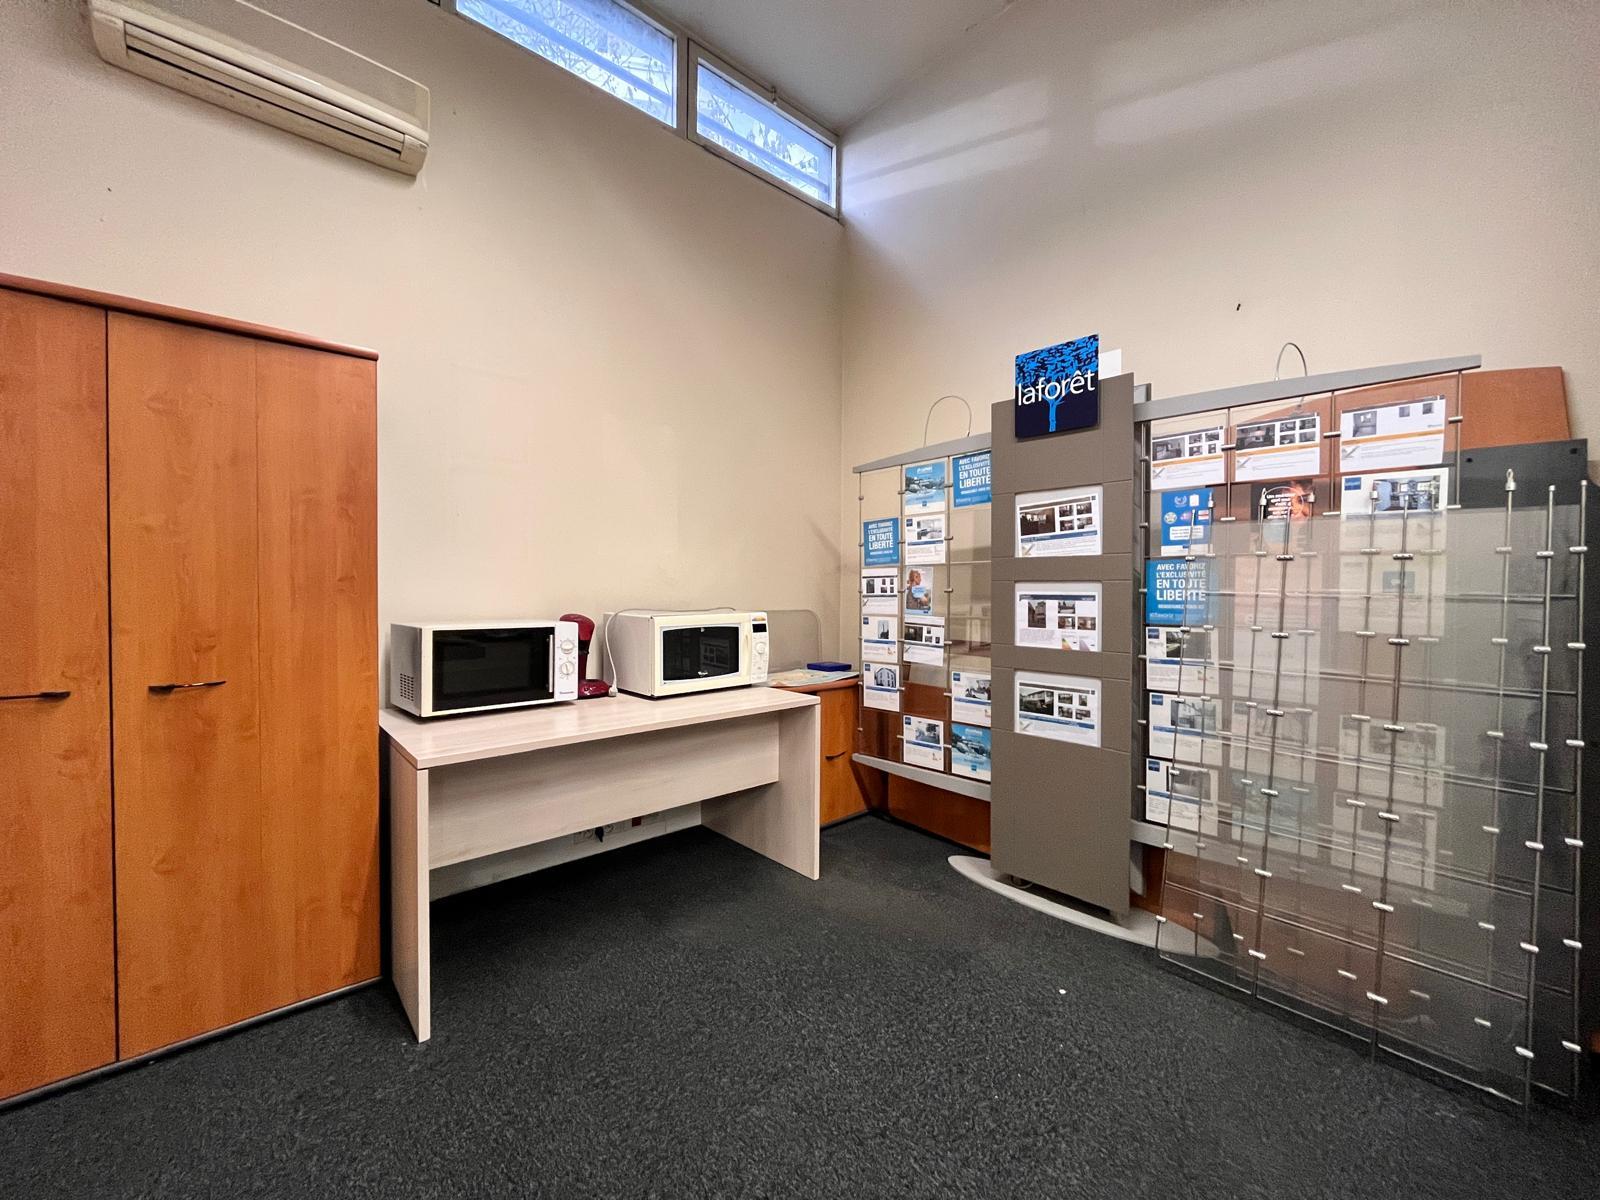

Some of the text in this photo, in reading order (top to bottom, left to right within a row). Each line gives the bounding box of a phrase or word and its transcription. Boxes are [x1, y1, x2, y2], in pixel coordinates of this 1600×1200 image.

[1018, 369, 1096, 406] laforêt
[959, 466, 991, 480] EN TOUTE
[1157, 563, 1175, 571] AVEC
[1156, 579, 1170, 589] EN
